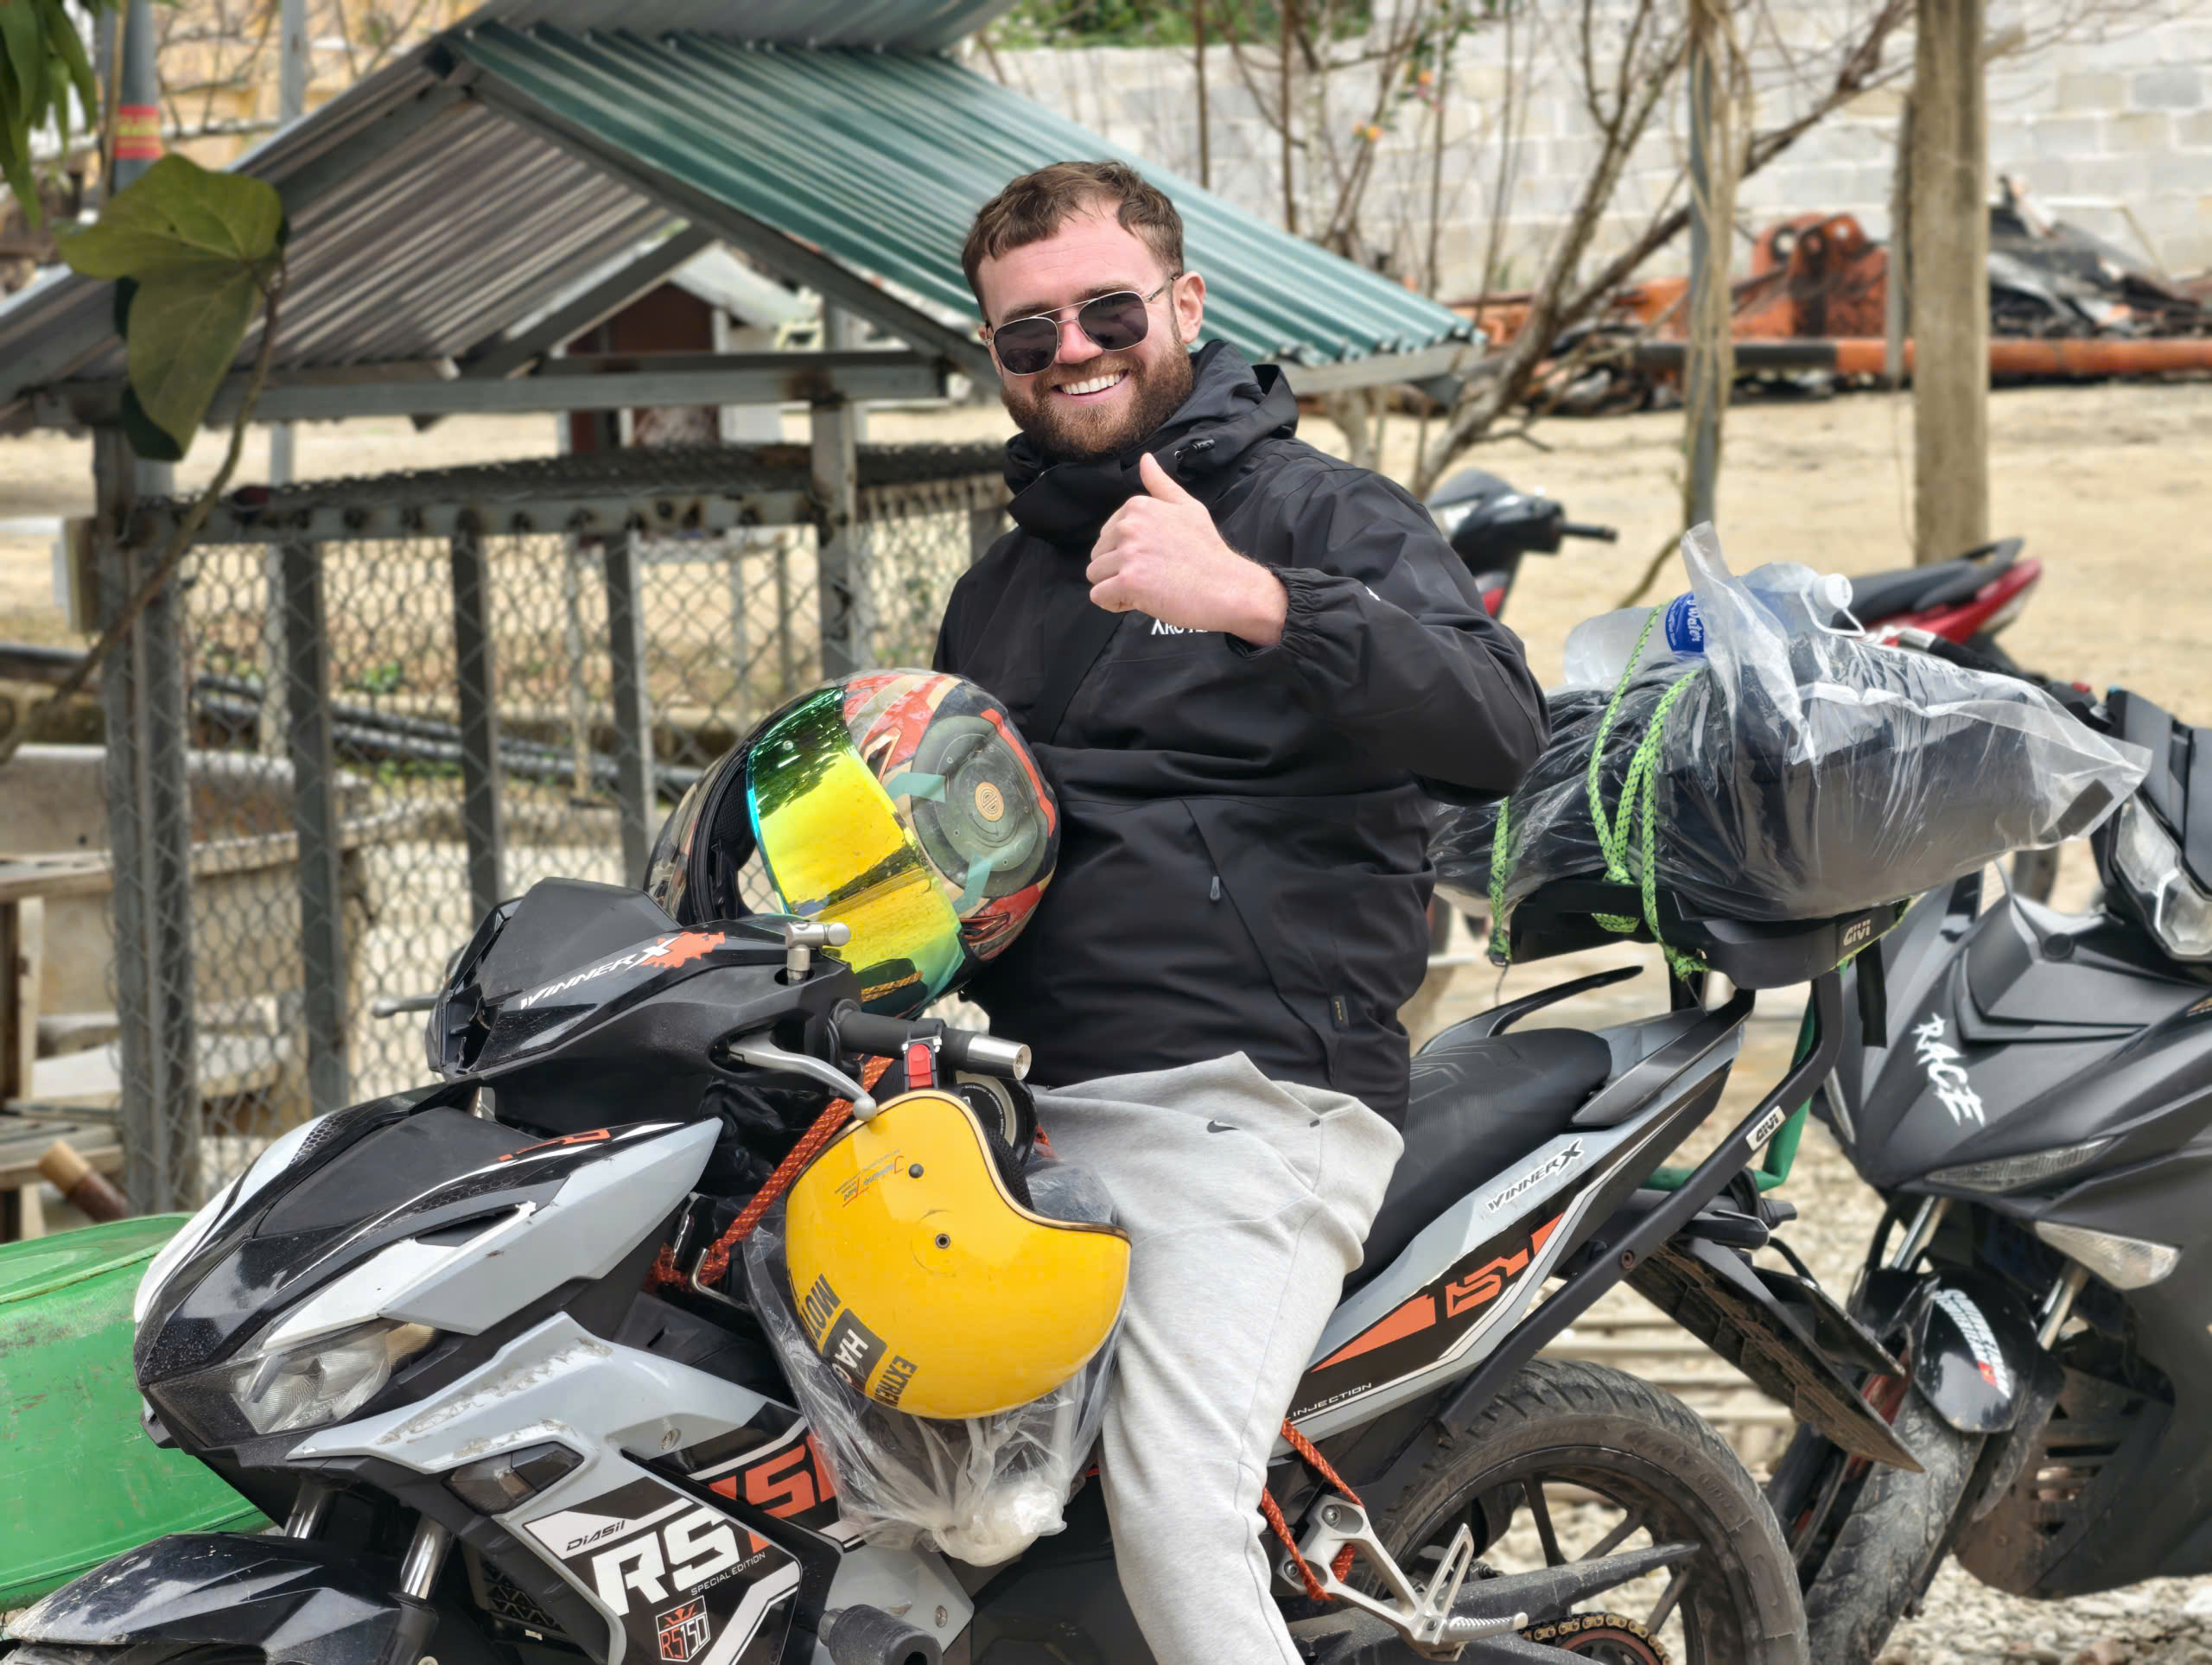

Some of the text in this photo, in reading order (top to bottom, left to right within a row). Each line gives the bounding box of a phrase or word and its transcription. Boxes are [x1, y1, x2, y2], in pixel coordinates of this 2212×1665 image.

[1910, 1011, 1986, 1128] RACE
[1293, 1382, 1372, 1417] INJECTION
[690, 1552, 766, 1596] SPECIAL EDITION
